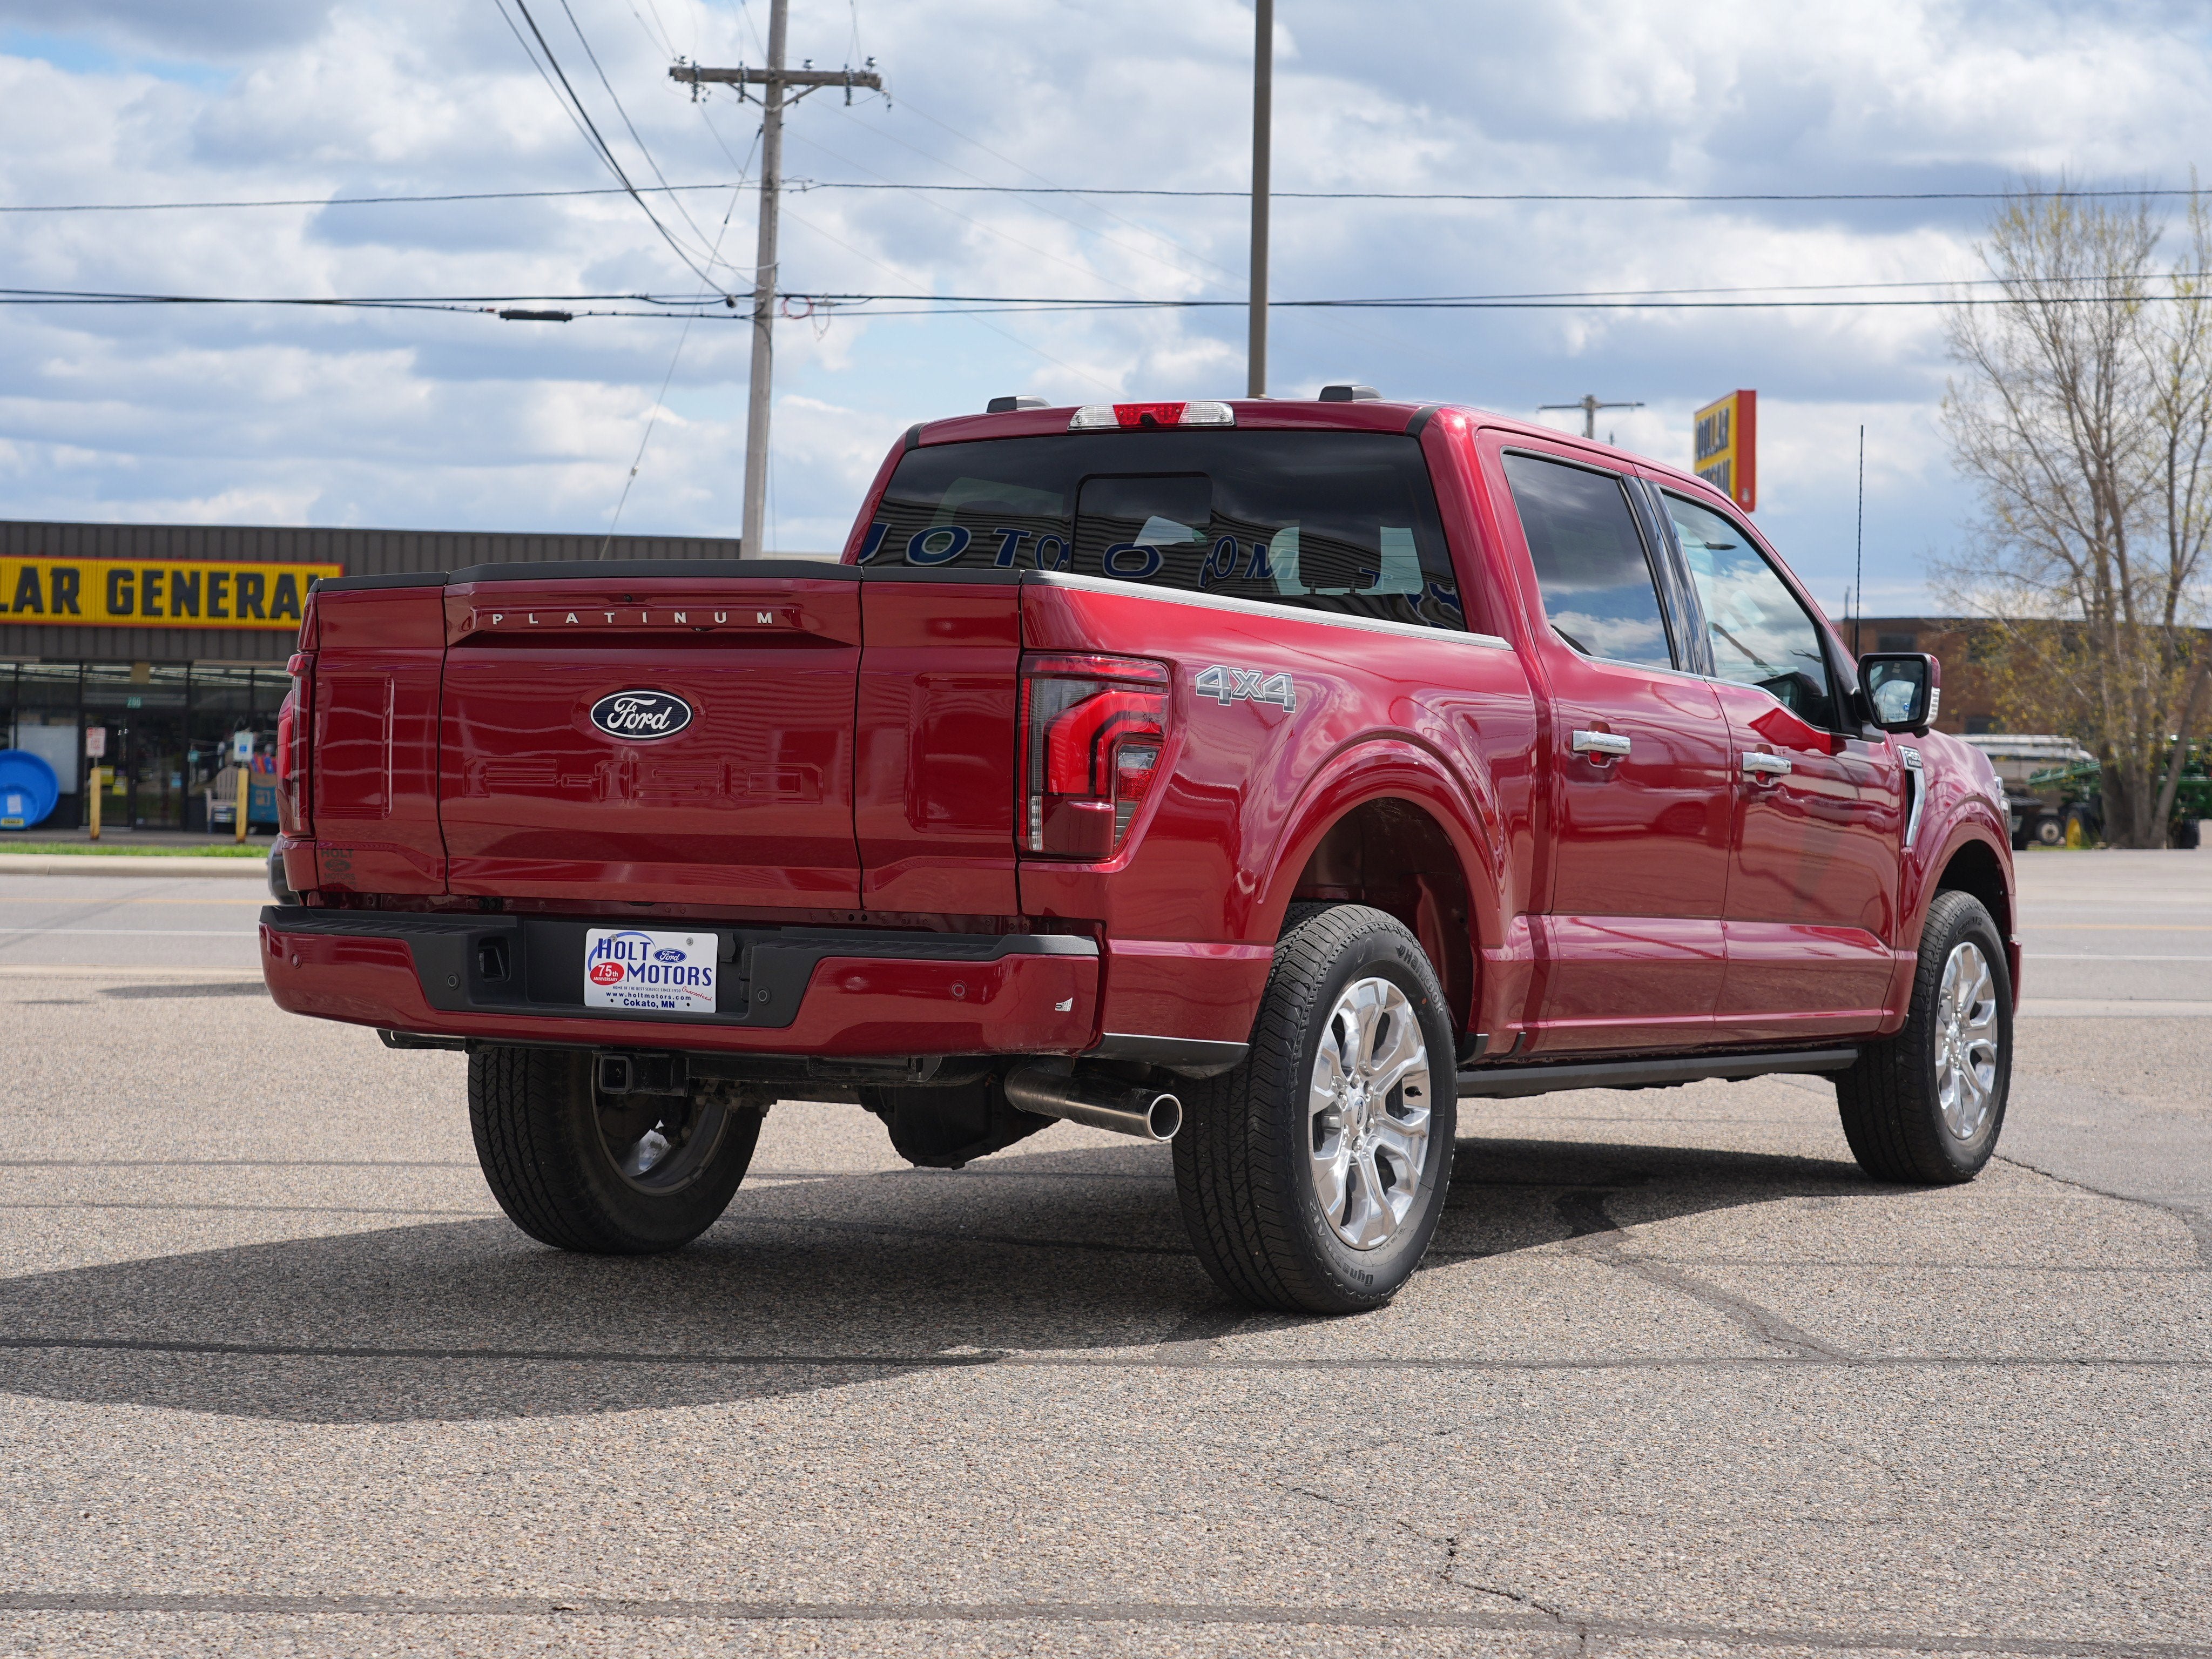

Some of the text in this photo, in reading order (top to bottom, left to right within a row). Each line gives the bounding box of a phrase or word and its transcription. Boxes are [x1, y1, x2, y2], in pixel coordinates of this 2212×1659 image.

[0, 567, 318, 619] AR GENERA
[492, 611, 773, 625] PLATINUM
[606, 697, 672, 730] Ford
[321, 848, 354, 858] HOLT
[597, 938, 651, 961] HOLT
[598, 965, 618, 977] 75th
[626, 962, 712, 987] MOTORS
[606, 992, 691, 1001] www.holtmotors.com
[682, 986, 712, 1001] Guaranteed
[623, 999, 675, 1009] Cokato, MN
